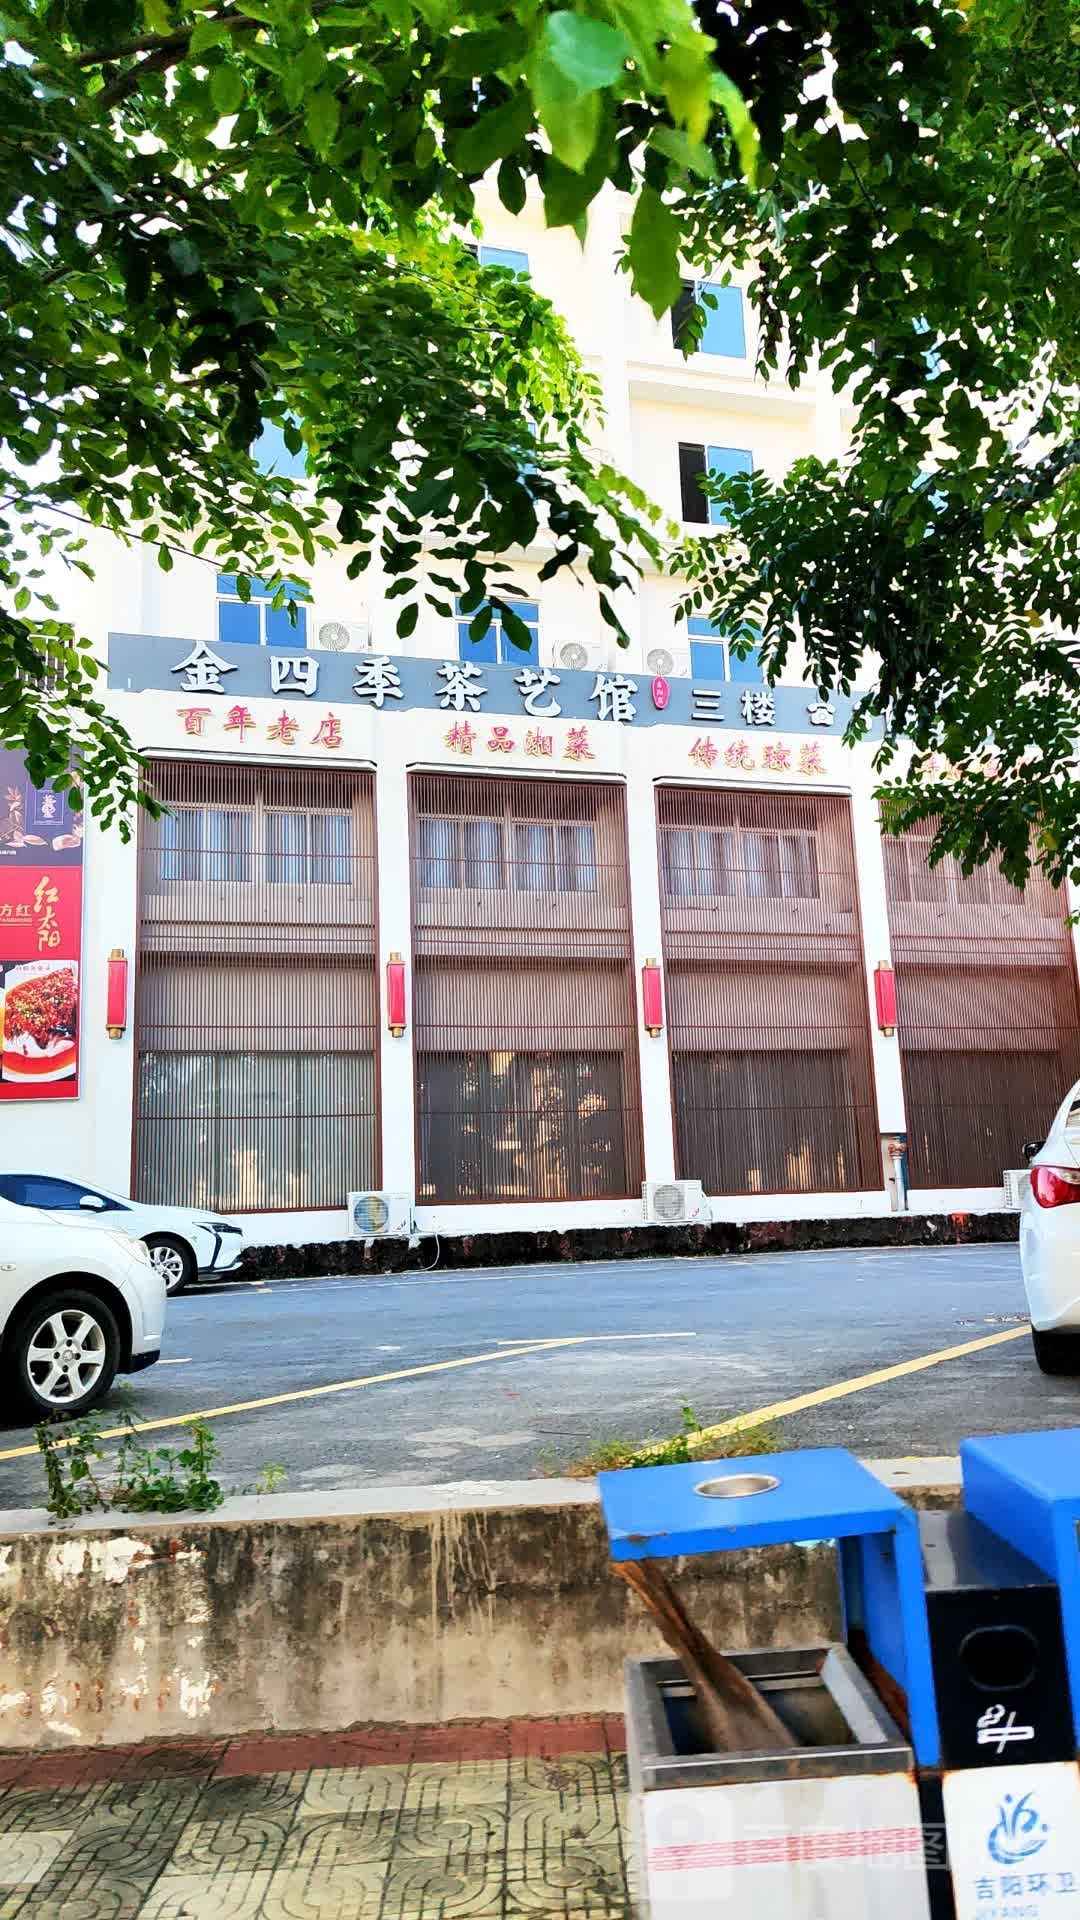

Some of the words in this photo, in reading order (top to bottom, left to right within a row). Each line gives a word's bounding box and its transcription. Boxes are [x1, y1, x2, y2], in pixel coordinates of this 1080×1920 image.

[170, 639, 637, 722] 金四季茶艺馆
[691, 689, 776, 727] 三楼
[176, 705, 344, 748] 百年老店
[445, 720, 596, 761] 精品湘菜
[33, 876, 61, 952] 红太阳
